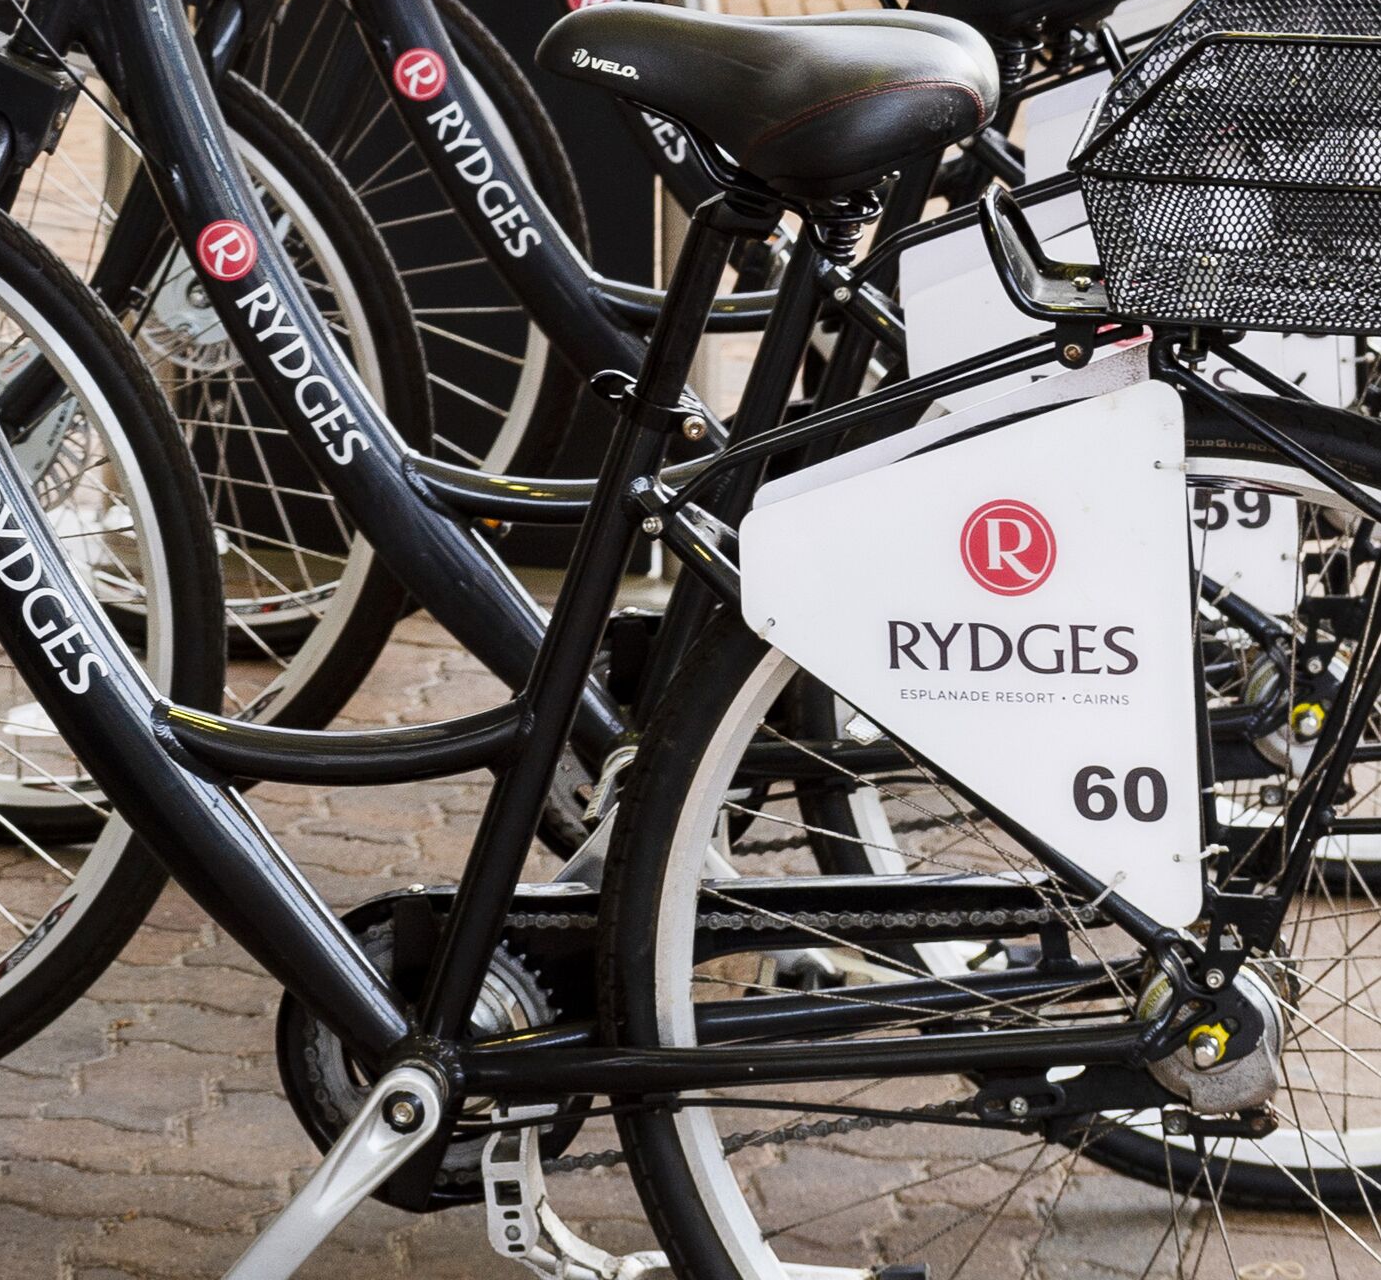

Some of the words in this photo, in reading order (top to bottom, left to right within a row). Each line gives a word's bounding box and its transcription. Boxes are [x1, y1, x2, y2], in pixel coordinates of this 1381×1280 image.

[590, 56, 638, 79] VELO
[426, 101, 542, 258] RYDGES
[235, 282, 370, 466] RYDGES
[1193, 486, 1272, 532] 59
[984, 518, 1041, 582] R
[888, 620, 1138, 676] RYDGES
[900, 689, 990, 703] ESPLANADE
[996, 691, 1055, 704] RESORT
[1073, 692, 1130, 706] CAIRNS
[1072, 765, 1168, 823] 60
